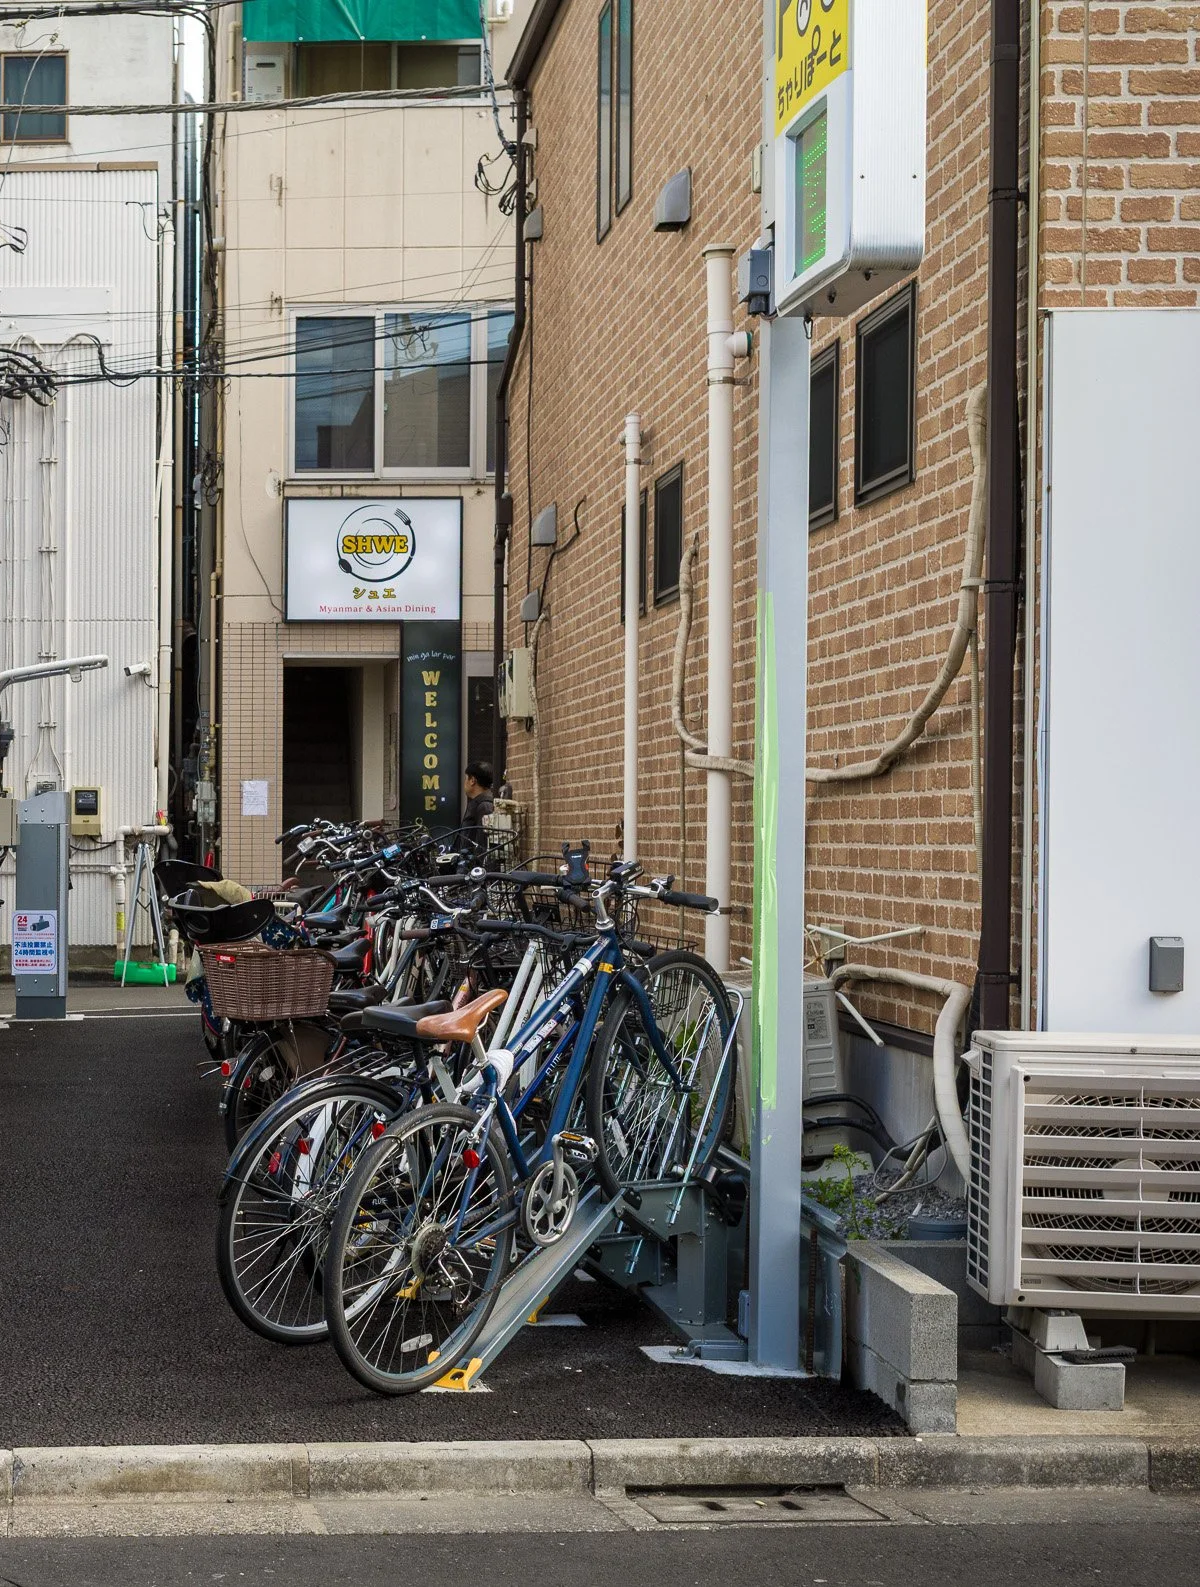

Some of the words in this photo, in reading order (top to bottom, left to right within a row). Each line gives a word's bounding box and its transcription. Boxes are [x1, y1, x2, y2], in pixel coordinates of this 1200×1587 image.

[777, 24, 841, 120] ちゃりぽーと
[342, 535, 408, 554] SHWE
[352, 587, 396, 599] シュエ
[319, 605, 362, 614] Myanmar
[405, 605, 436, 614] Dining
[421, 670, 441, 811] WELCOME
